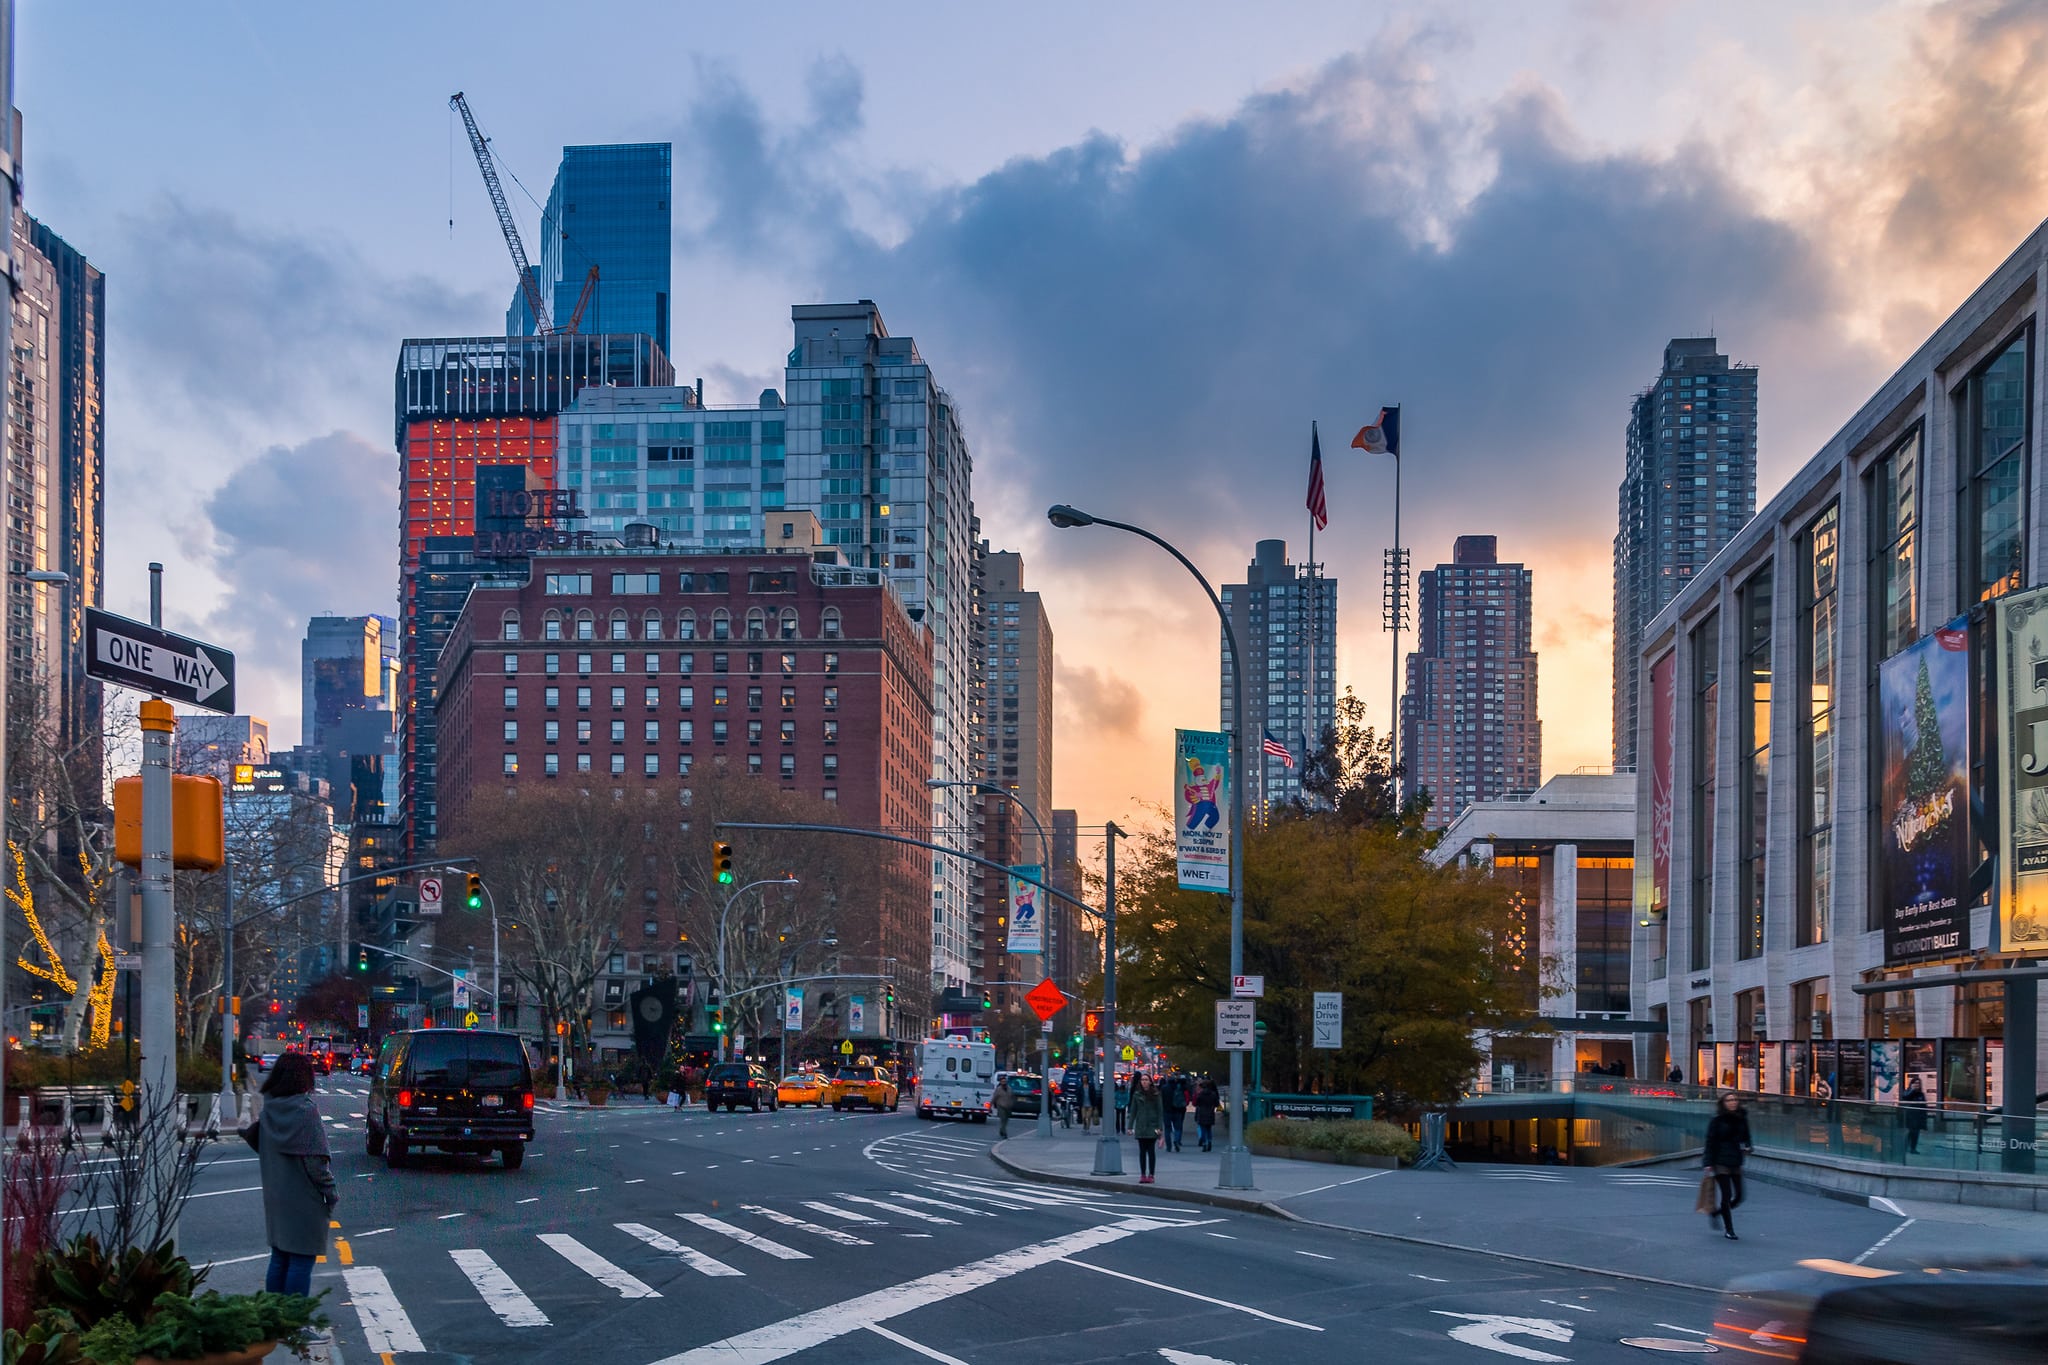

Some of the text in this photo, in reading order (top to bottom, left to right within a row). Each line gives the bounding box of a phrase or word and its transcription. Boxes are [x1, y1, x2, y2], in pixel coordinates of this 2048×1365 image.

[488, 489, 585, 517] HOTEL
[109, 637, 214, 689] ONE WAY
[1180, 744, 1197, 754] EVE
[2022, 856, 2048, 866] AYAD
[1183, 869, 1210, 880] WNET
[1919, 902, 1928, 913] For
[1928, 900, 1940, 911] Best
[1940, 897, 1957, 909] Seats
[1920, 936, 1934, 951] CITY
[1934, 932, 1960, 949] BALLET
[1316, 1001, 1338, 1010] Jaffe
[1315, 1010, 1339, 1019] Drive
[2010, 1138, 2039, 1151] Drive
